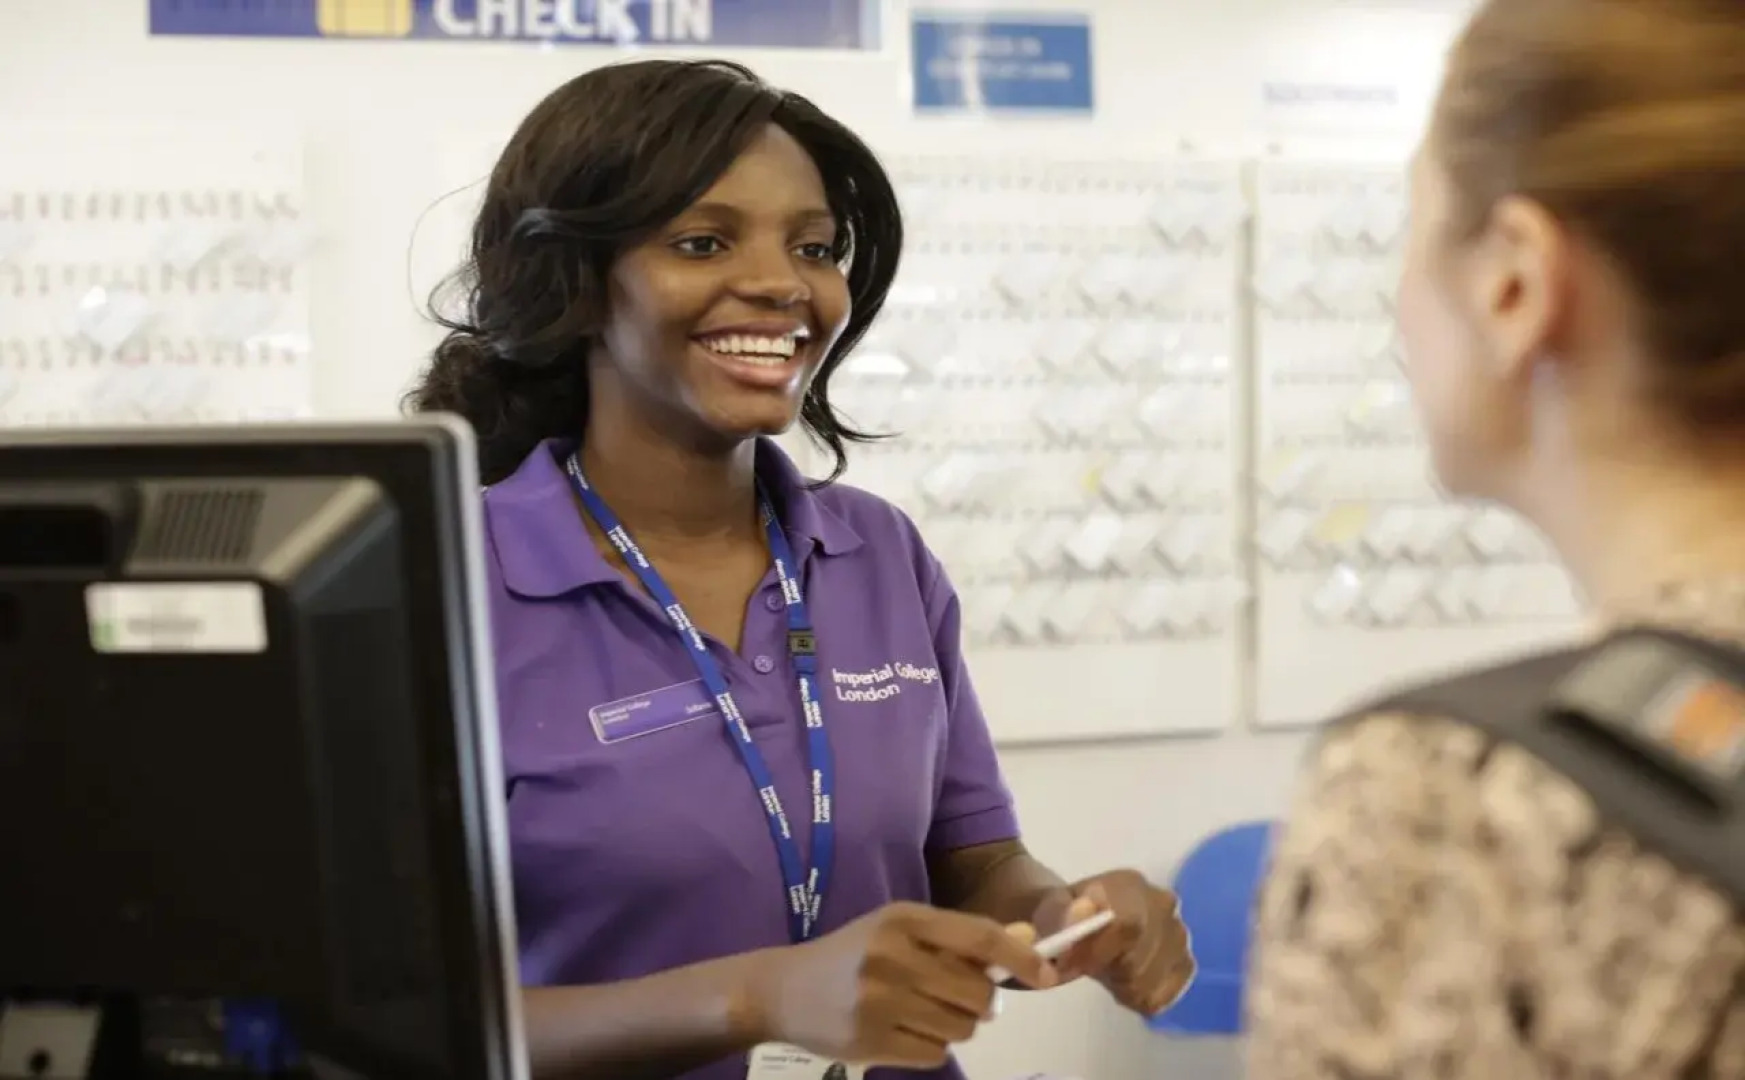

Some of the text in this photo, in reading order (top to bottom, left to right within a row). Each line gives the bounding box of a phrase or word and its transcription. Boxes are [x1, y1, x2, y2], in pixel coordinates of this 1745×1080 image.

[432, 0, 712, 43] CHECK IN
[832, 662, 939, 688] Imperial College
[835, 684, 900, 702] London
